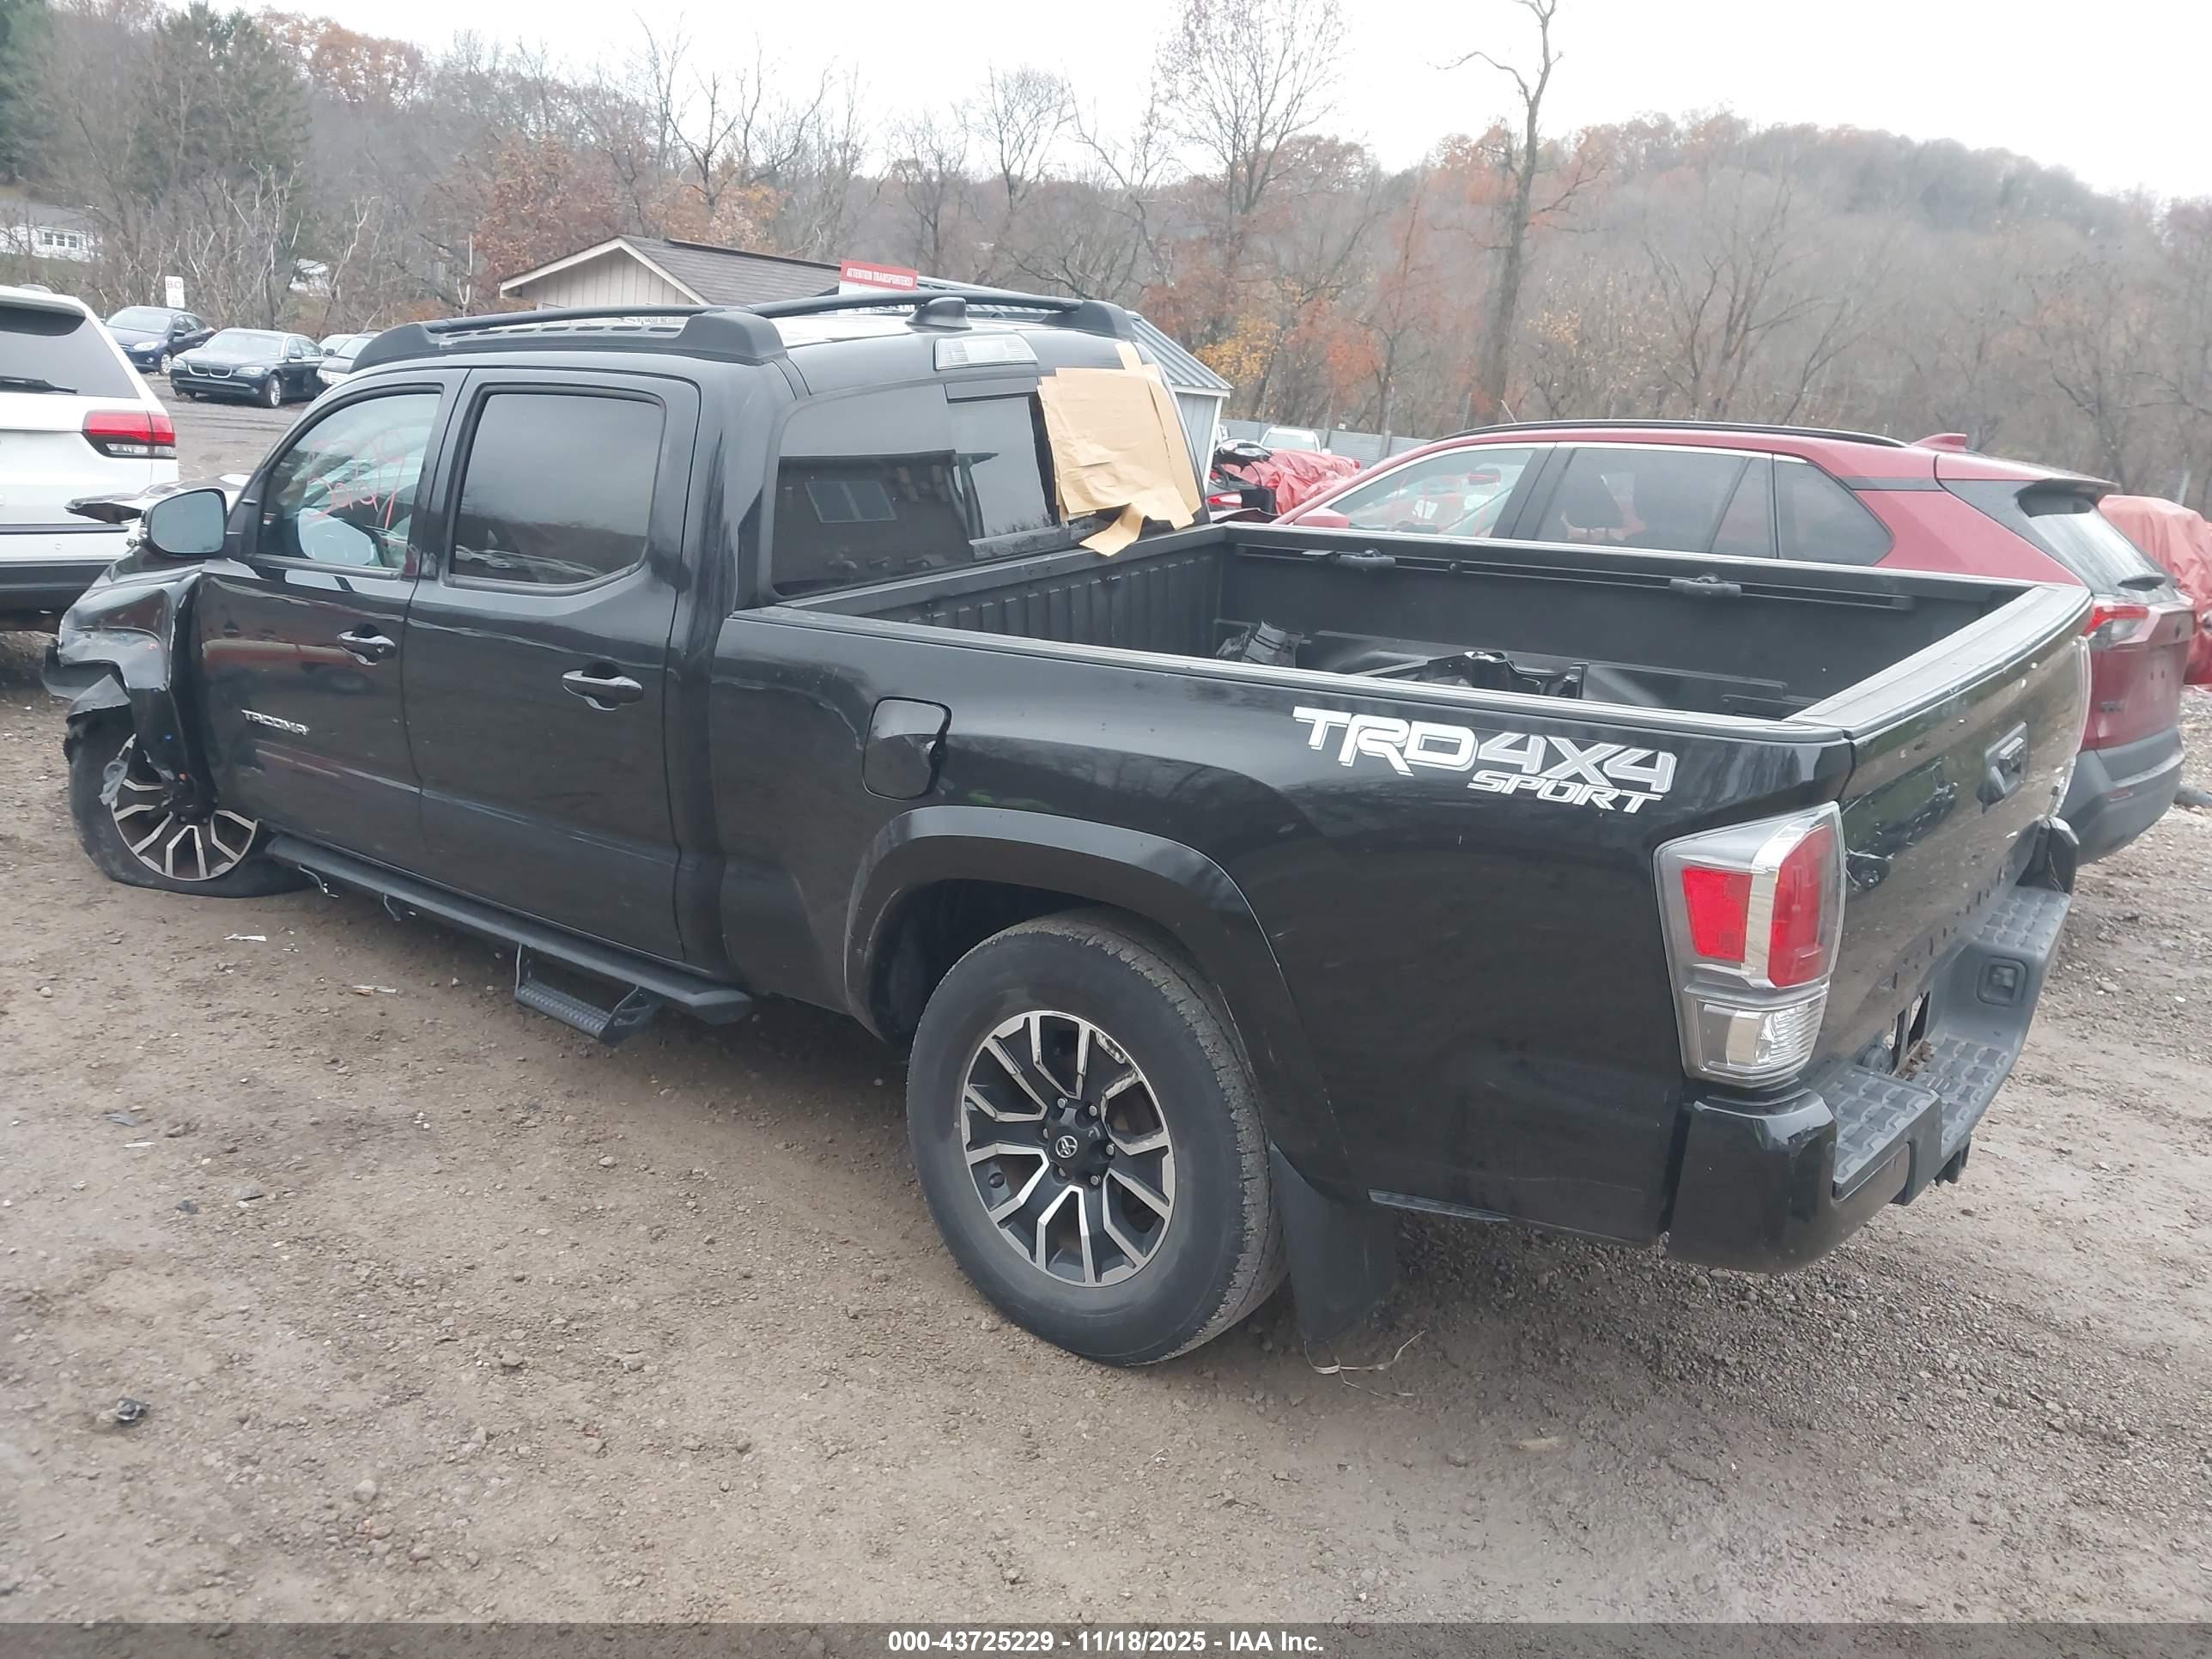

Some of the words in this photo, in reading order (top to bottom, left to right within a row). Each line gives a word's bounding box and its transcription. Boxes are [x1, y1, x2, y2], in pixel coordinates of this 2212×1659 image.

[241, 708, 310, 735] TACOMA
[1292, 705, 1480, 777] TRD
[1467, 769, 1663, 815] SPORT
